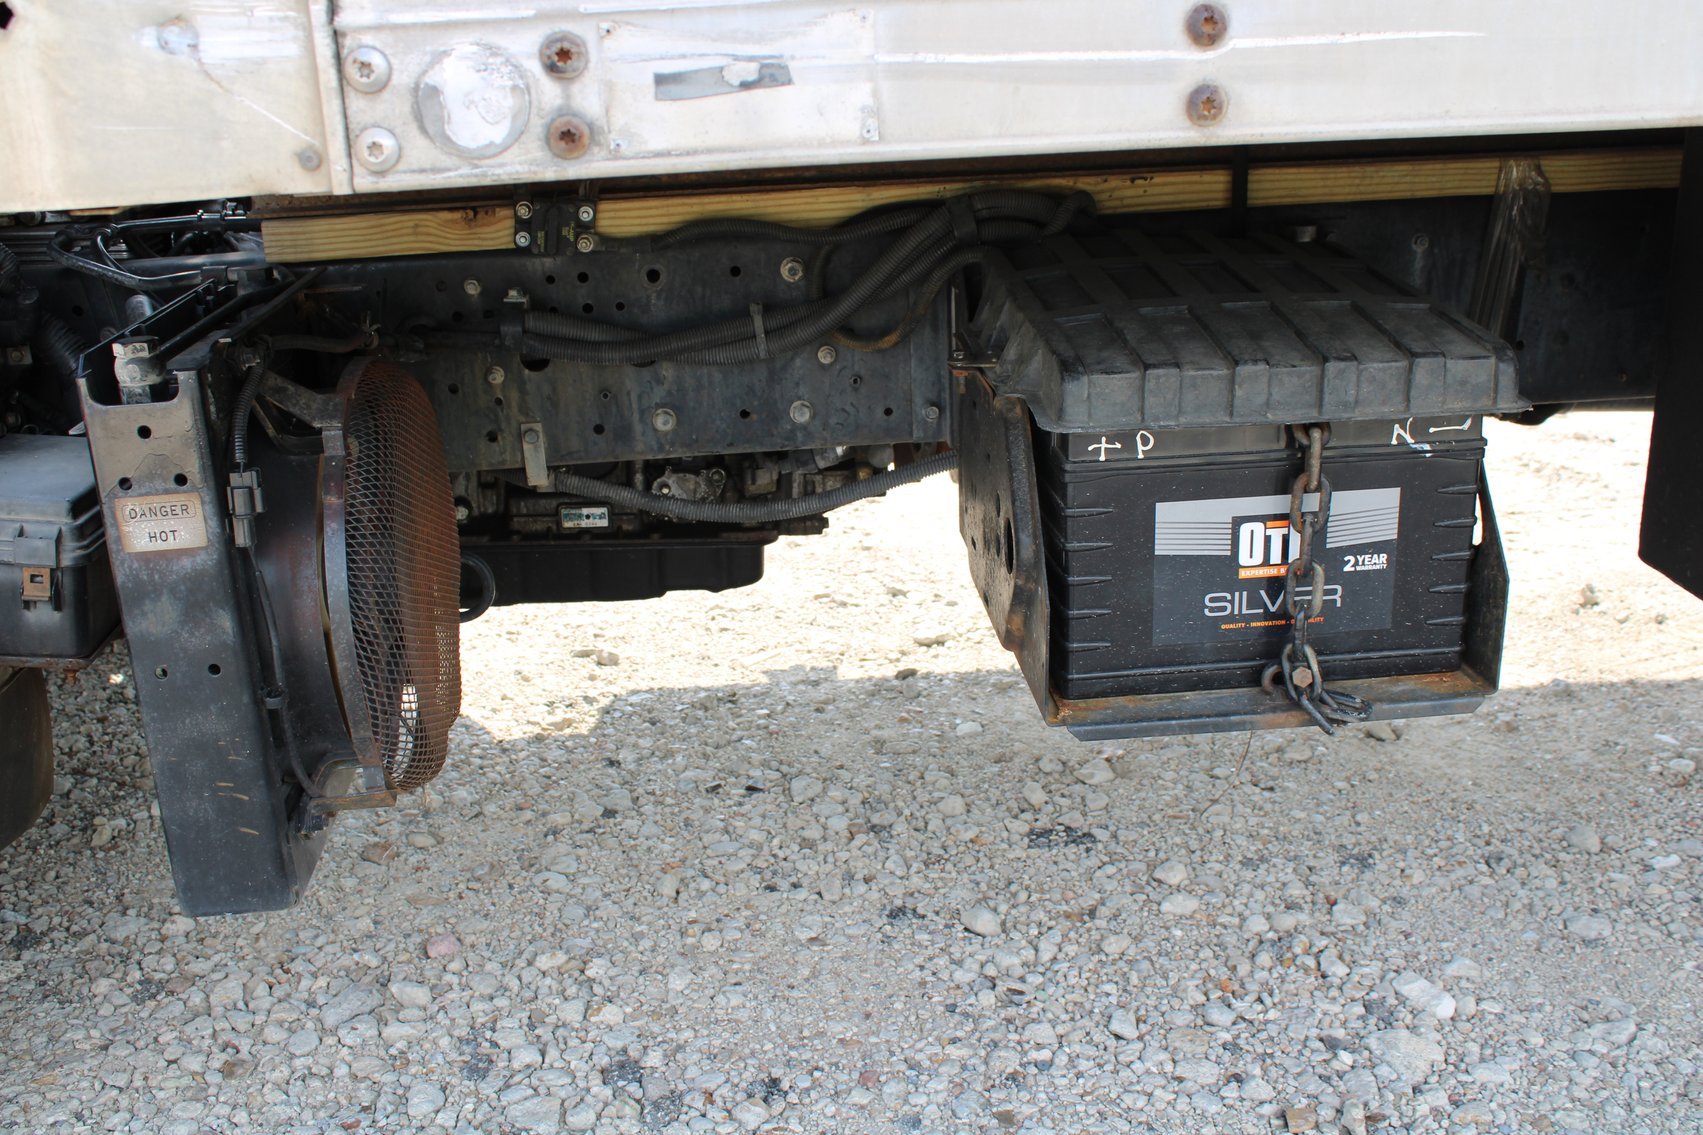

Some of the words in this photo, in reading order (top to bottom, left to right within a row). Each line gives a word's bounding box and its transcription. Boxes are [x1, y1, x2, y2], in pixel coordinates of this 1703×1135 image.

[1391, 416, 1415, 445] N
[1136, 430, 1154, 459] P
[128, 503, 190, 520] DANGER
[148, 529, 178, 543] HOT
[1343, 555, 1356, 572] 2
[1356, 553, 1388, 566] YEAR
[1355, 563, 1388, 571] WARRANTY
[1241, 568, 1278, 577] EXPERTISE
